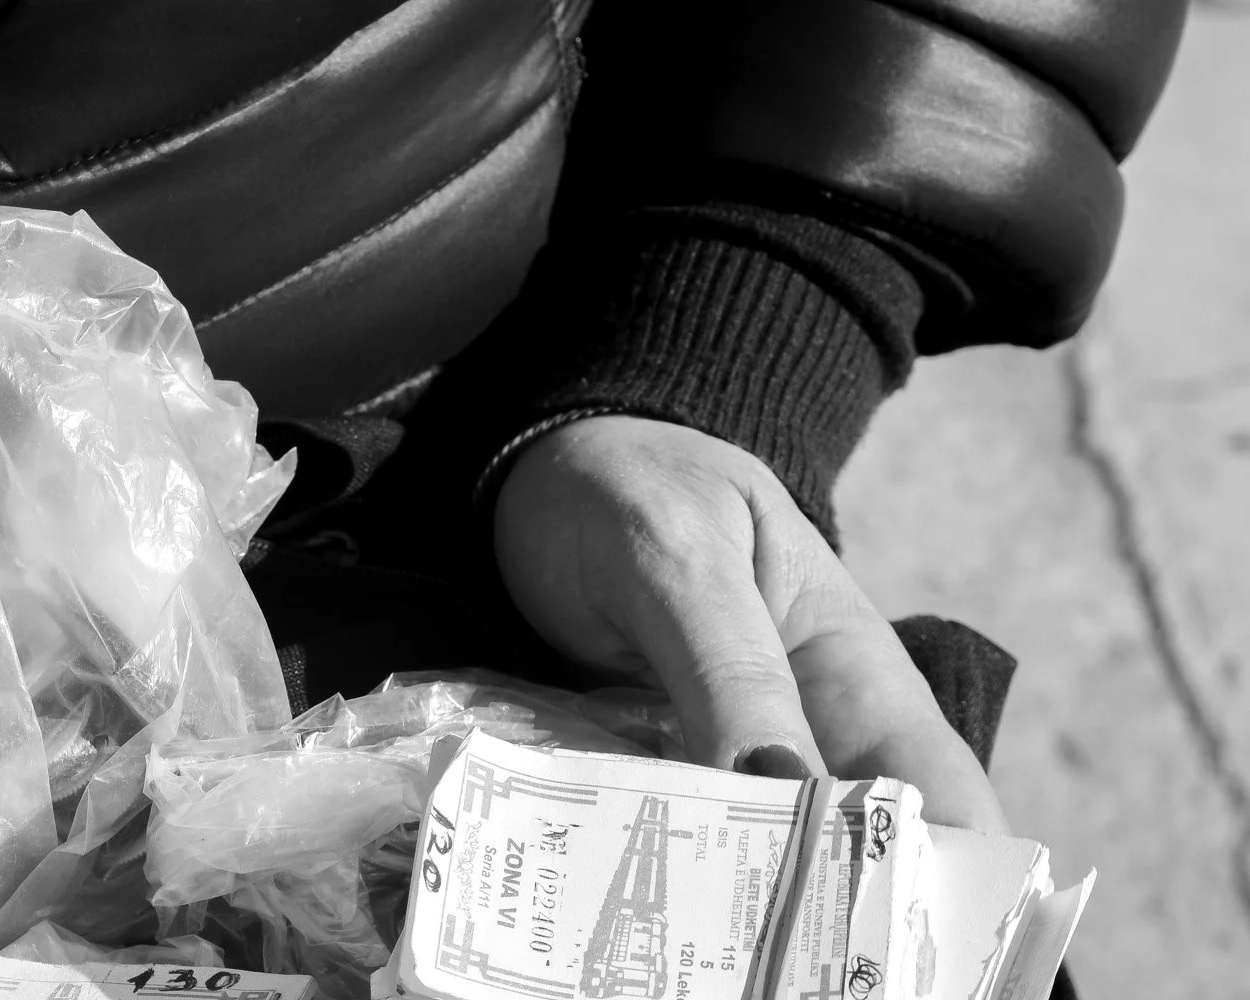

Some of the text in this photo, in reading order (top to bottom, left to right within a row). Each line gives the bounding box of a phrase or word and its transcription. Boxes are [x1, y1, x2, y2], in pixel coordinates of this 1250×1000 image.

[423, 804, 456, 893] 120
[695, 824, 709, 862] TOTAL
[734, 828, 750, 867] VLEFTA
[477, 844, 498, 909] Seria A/11
[496, 837, 526, 929] ZONA VI
[816, 848, 828, 894] MINISTRIA
[529, 867, 560, 953] 022400
[700, 826, 729, 969] ISIS 5
[729, 876, 745, 941] UDHETIMIT
[742, 867, 762, 952] BILETE UDHETIMI
[813, 903, 825, 937] PUNEVE
[680, 941, 696, 967] 120
[720, 944, 737, 972] 115
[810, 939, 821, 977] PUBLIKE
[126, 967, 241, 993] 130
